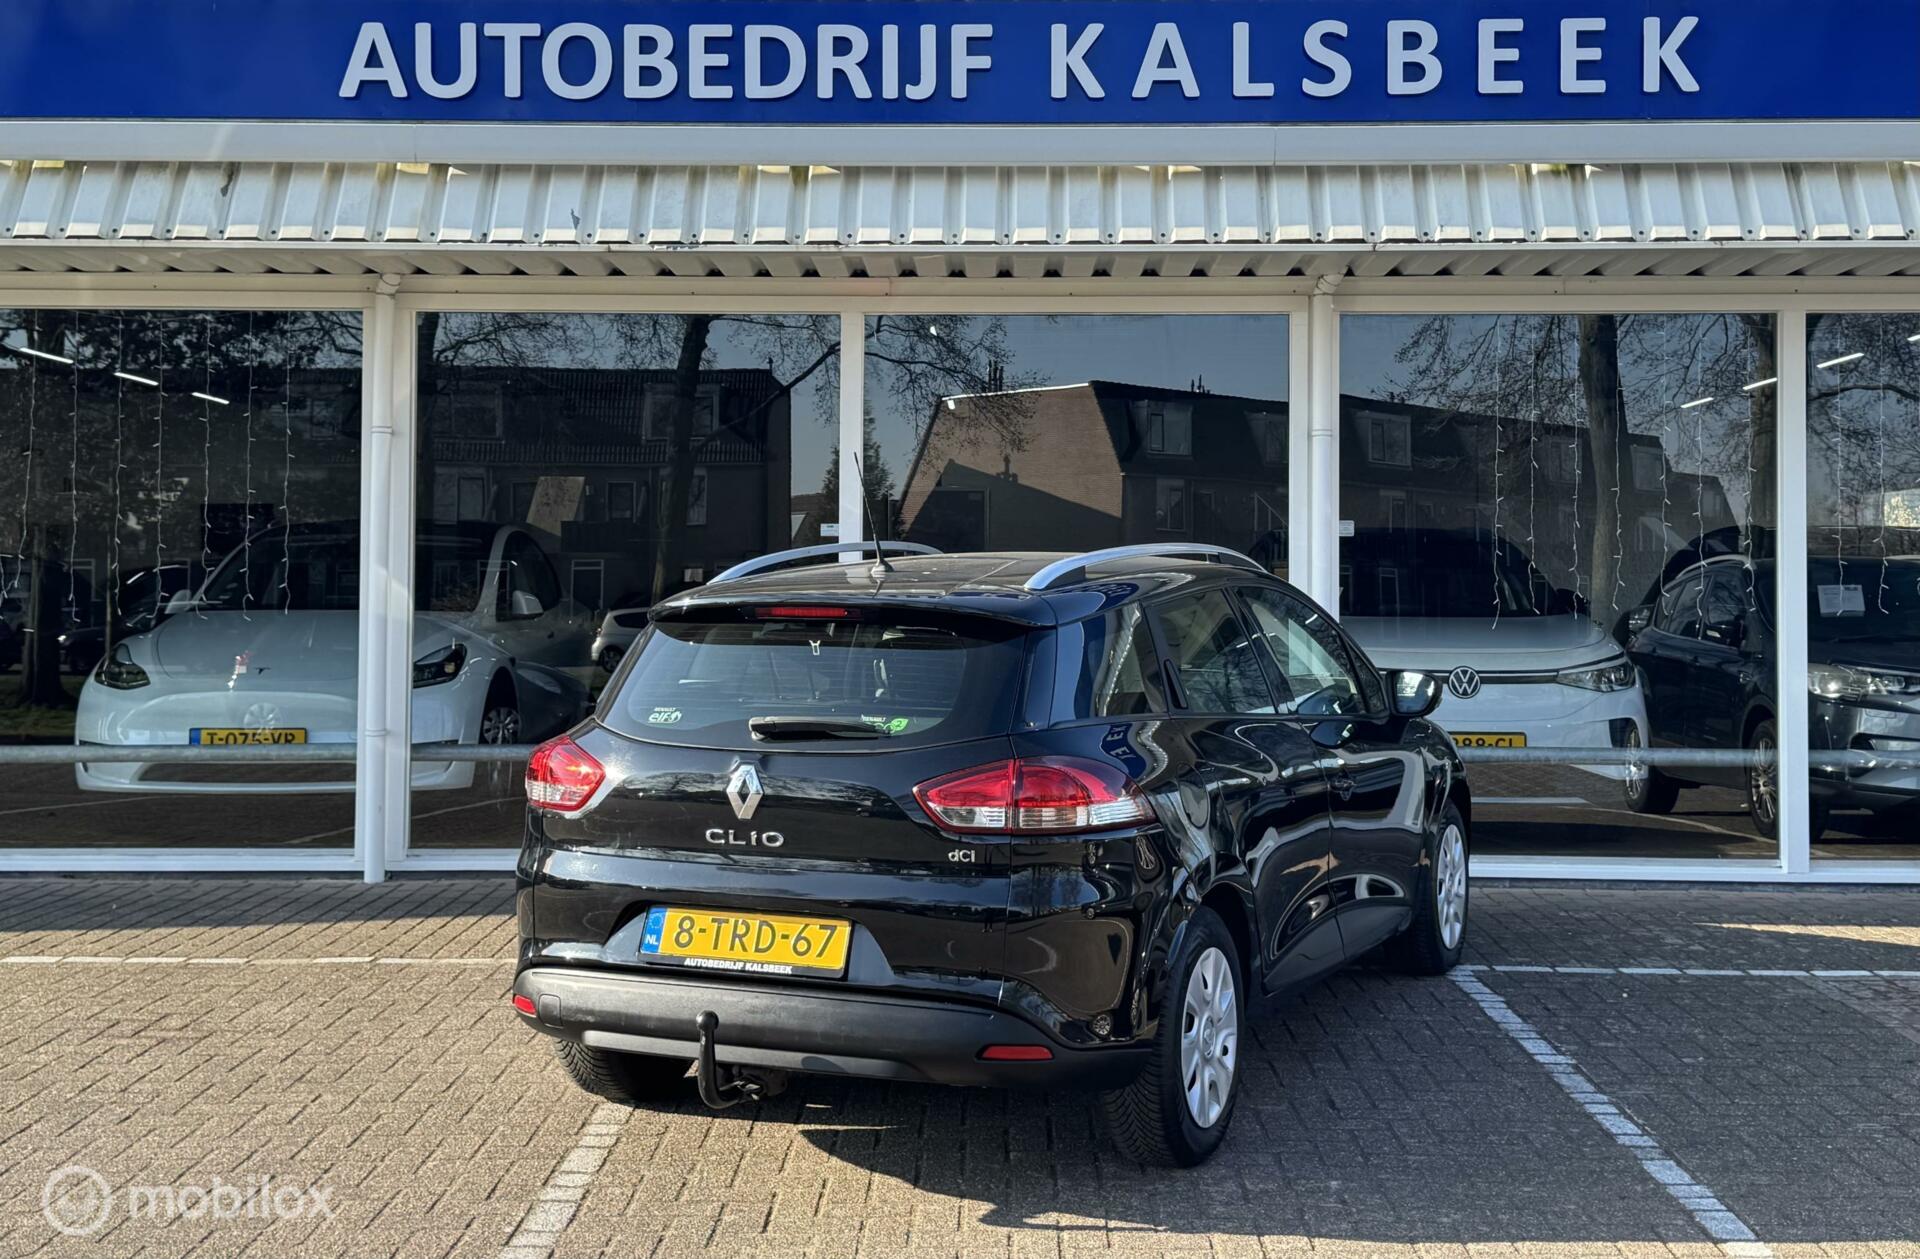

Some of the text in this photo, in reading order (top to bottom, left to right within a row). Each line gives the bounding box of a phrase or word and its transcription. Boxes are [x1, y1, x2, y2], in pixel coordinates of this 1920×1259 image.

[339, 16, 1700, 100] AUTOBEDRIJF KALSBEEK
[645, 935, 659, 946] NL
[674, 915, 838, 958] 8-TRD-67
[684, 957, 793, 975] AUTOBEDRIJF KALSBEEK
